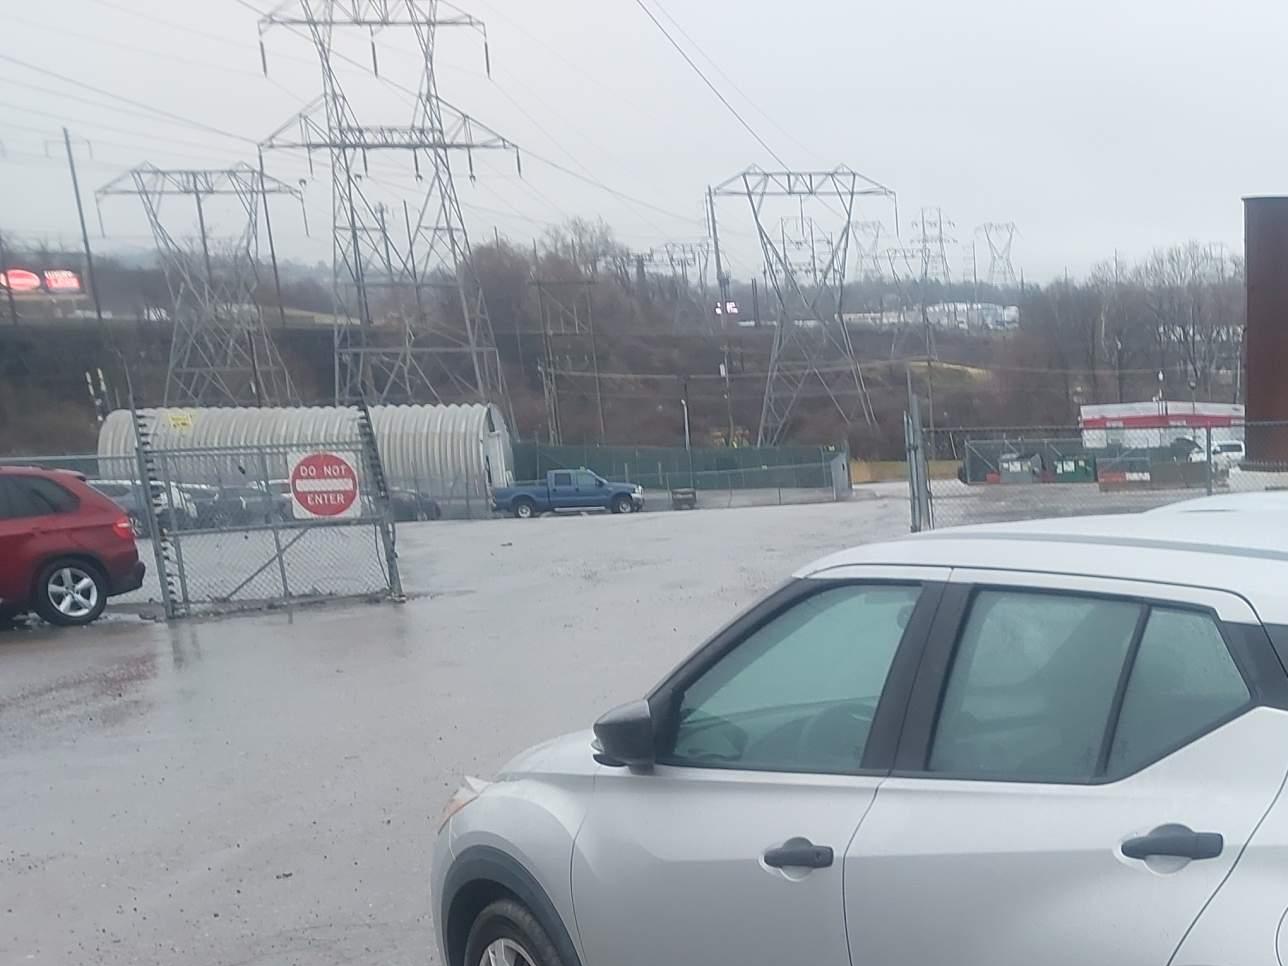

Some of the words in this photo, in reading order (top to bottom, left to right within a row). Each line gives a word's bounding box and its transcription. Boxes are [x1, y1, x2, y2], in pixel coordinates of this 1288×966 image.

[300, 465, 316, 476] DO
[323, 465, 346, 476] NOT
[307, 493, 345, 505] ENTER
